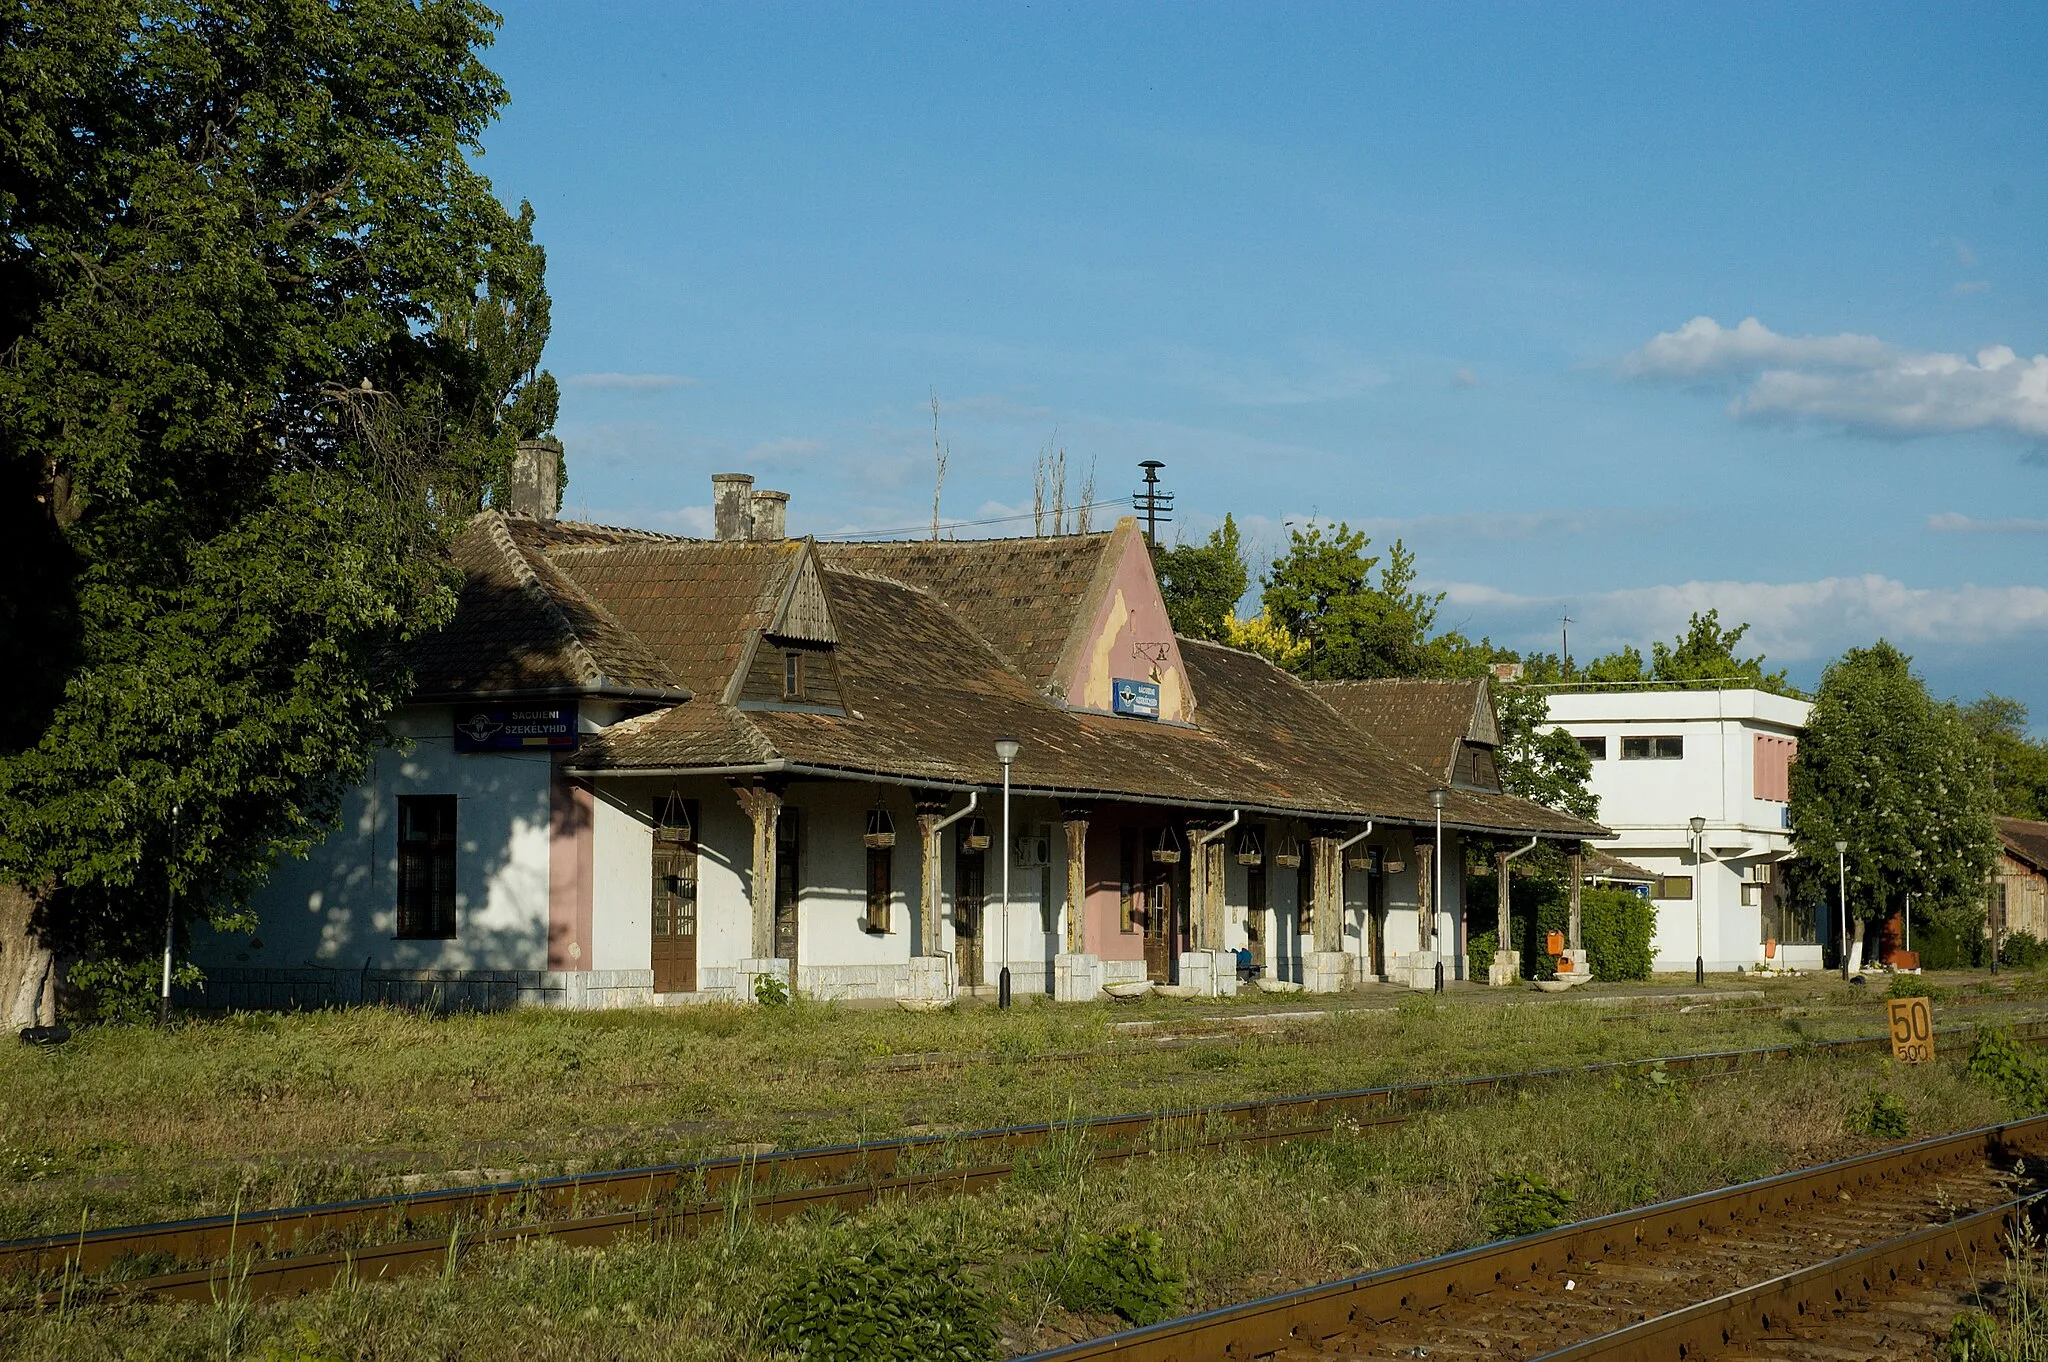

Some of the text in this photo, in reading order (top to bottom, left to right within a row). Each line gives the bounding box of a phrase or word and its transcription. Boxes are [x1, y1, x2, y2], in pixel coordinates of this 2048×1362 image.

[505, 721, 567, 734] SZEKÉLYHID
[1891, 1001, 1930, 1043] 50
[1898, 1044, 1928, 1062] 500
